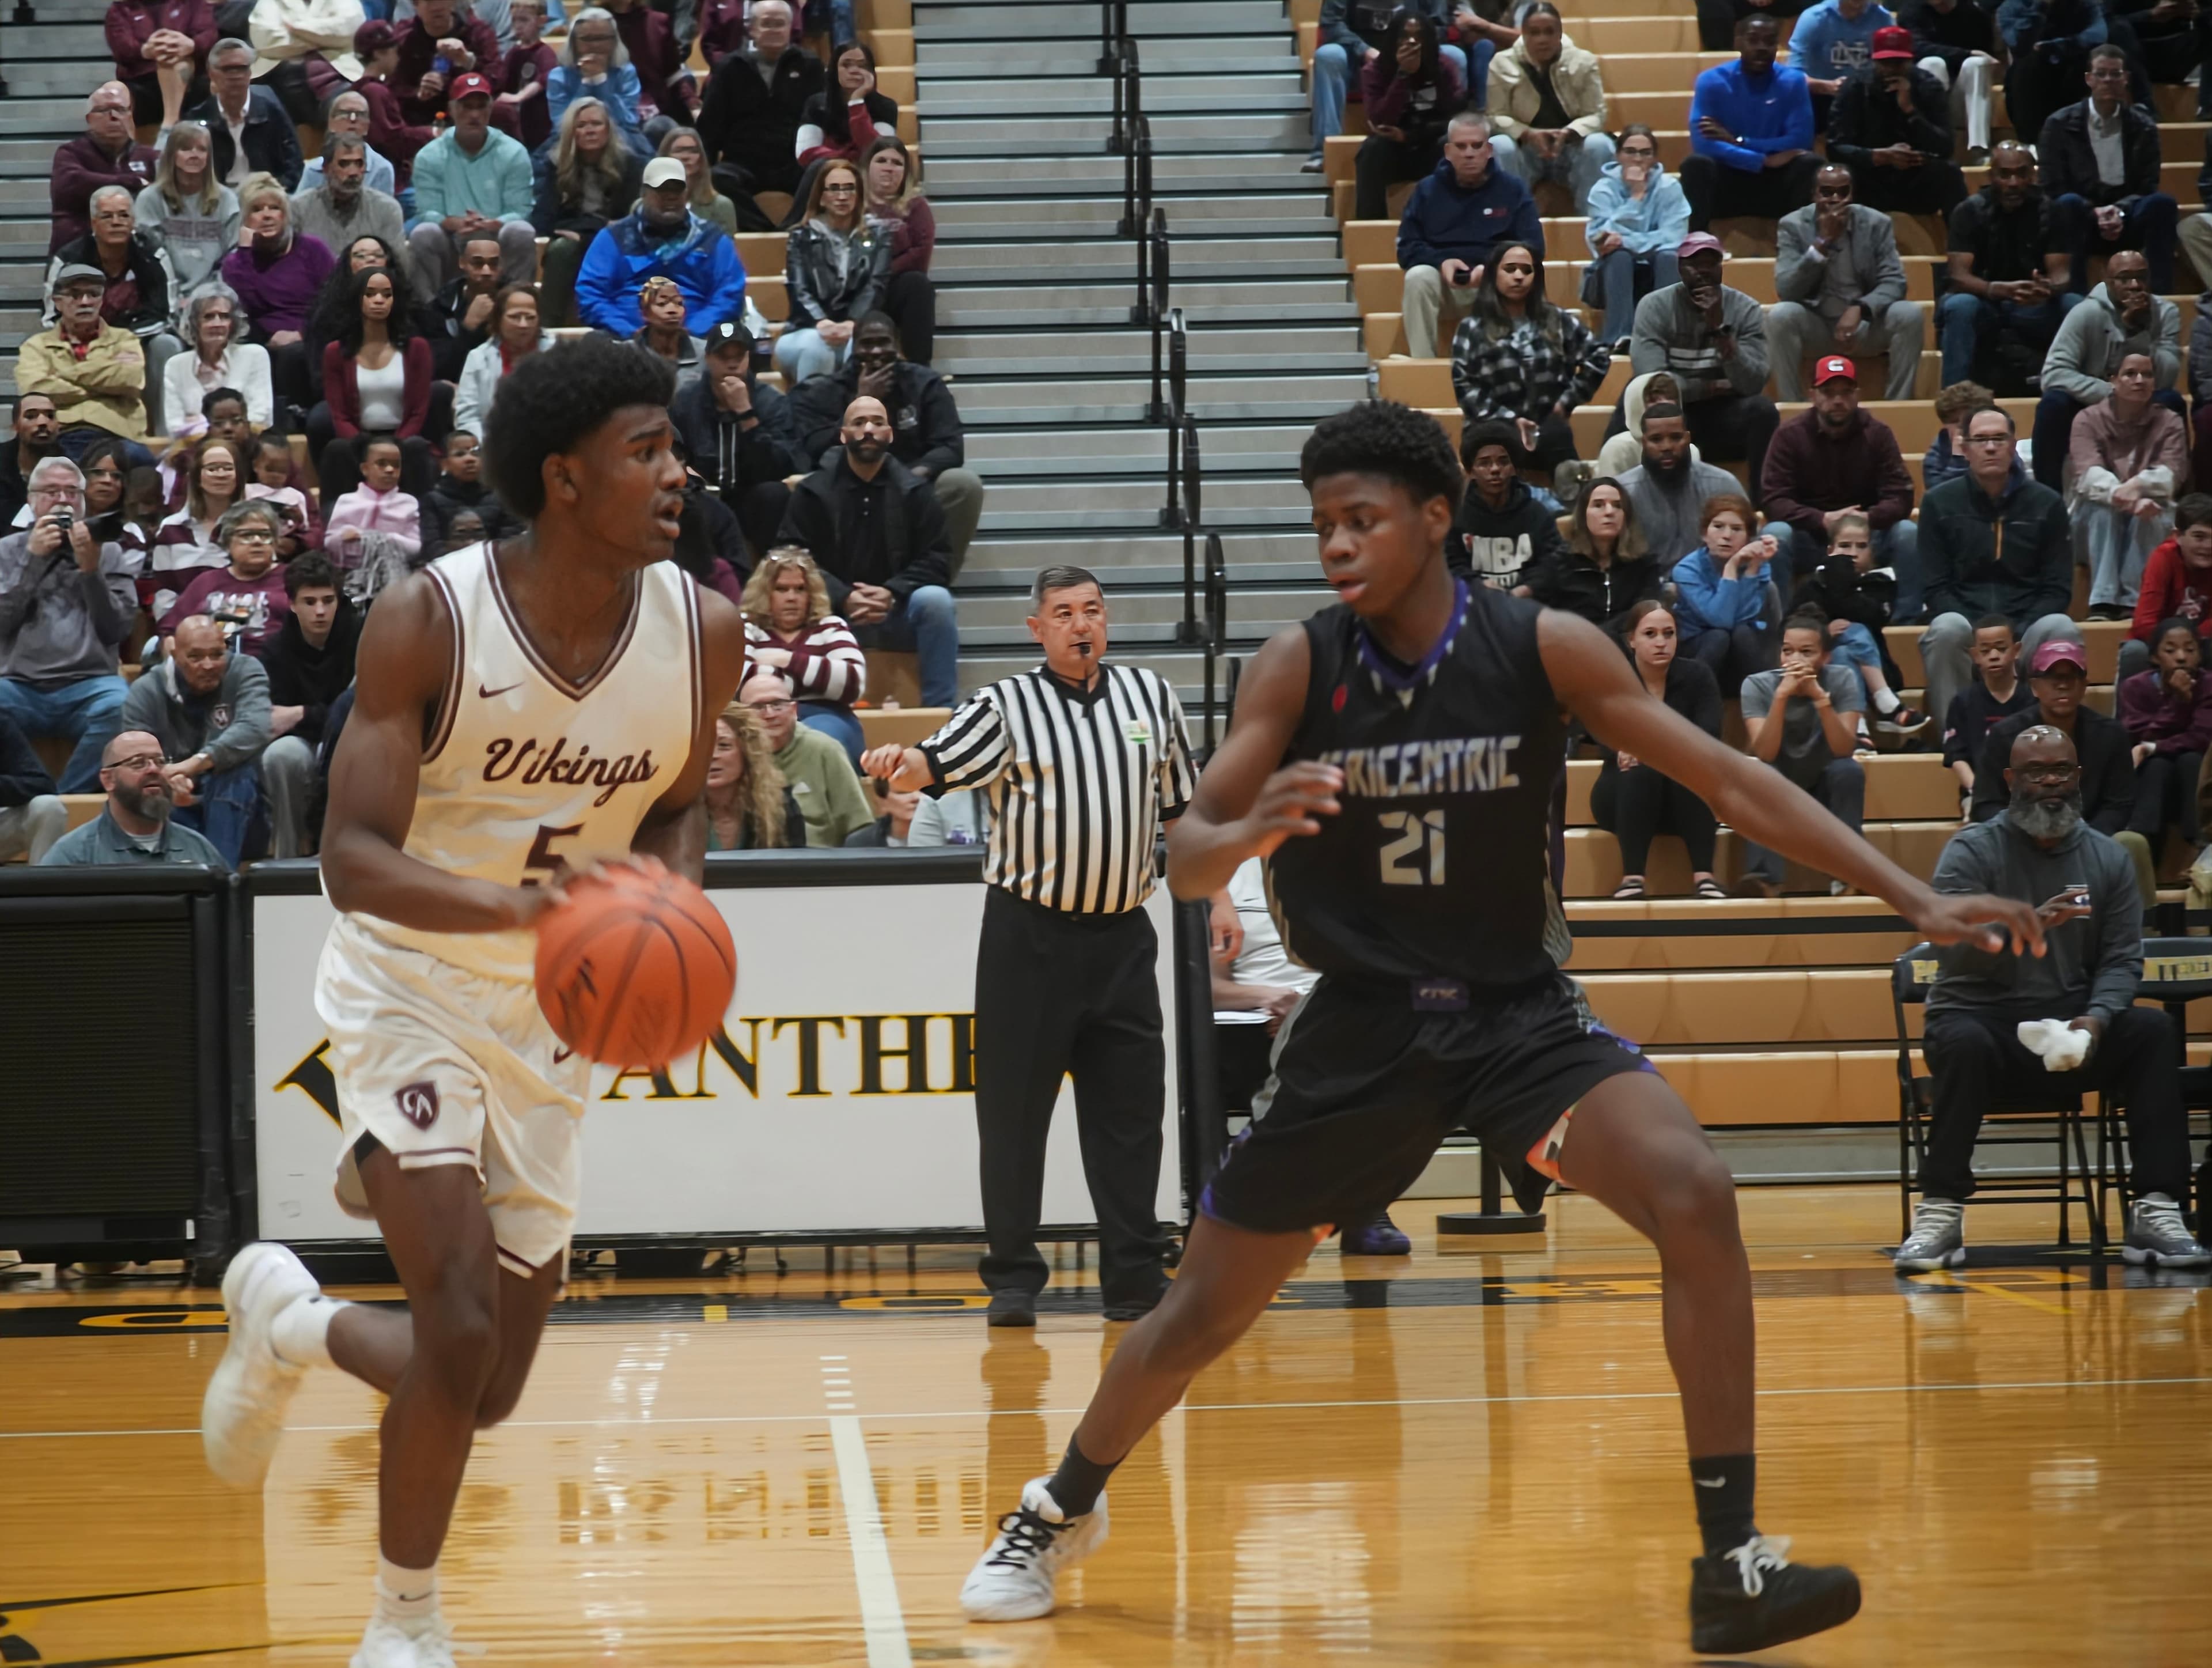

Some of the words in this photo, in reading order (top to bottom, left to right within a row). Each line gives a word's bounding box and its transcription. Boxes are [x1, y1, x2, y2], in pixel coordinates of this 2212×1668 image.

[483, 737, 660, 807] Vikings
[1318, 735, 1521, 797] RICENTRIC
[520, 821, 585, 888] 5
[1378, 810, 1445, 886] 21
